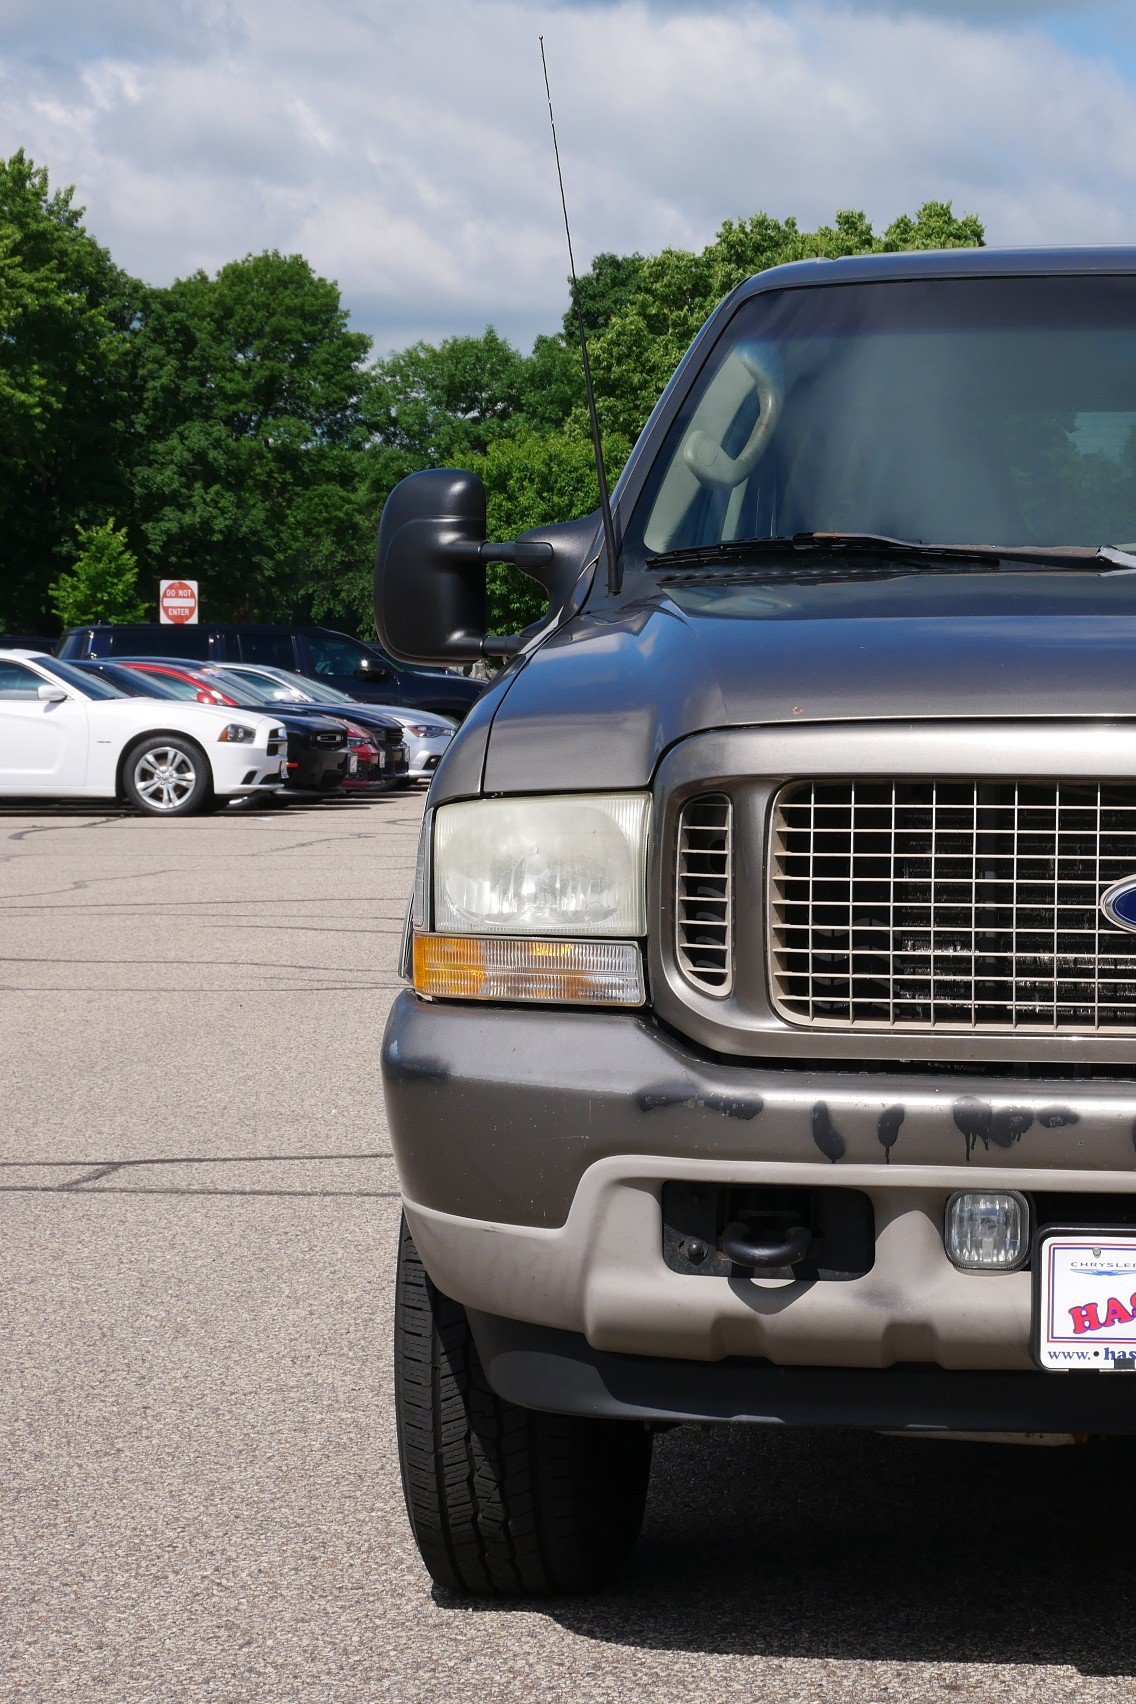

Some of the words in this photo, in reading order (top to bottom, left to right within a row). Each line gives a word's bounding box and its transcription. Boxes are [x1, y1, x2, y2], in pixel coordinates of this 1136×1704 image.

[166, 589, 176, 597] DO
[178, 589, 191, 597] NOT
[168, 608, 190, 616] ENTER
